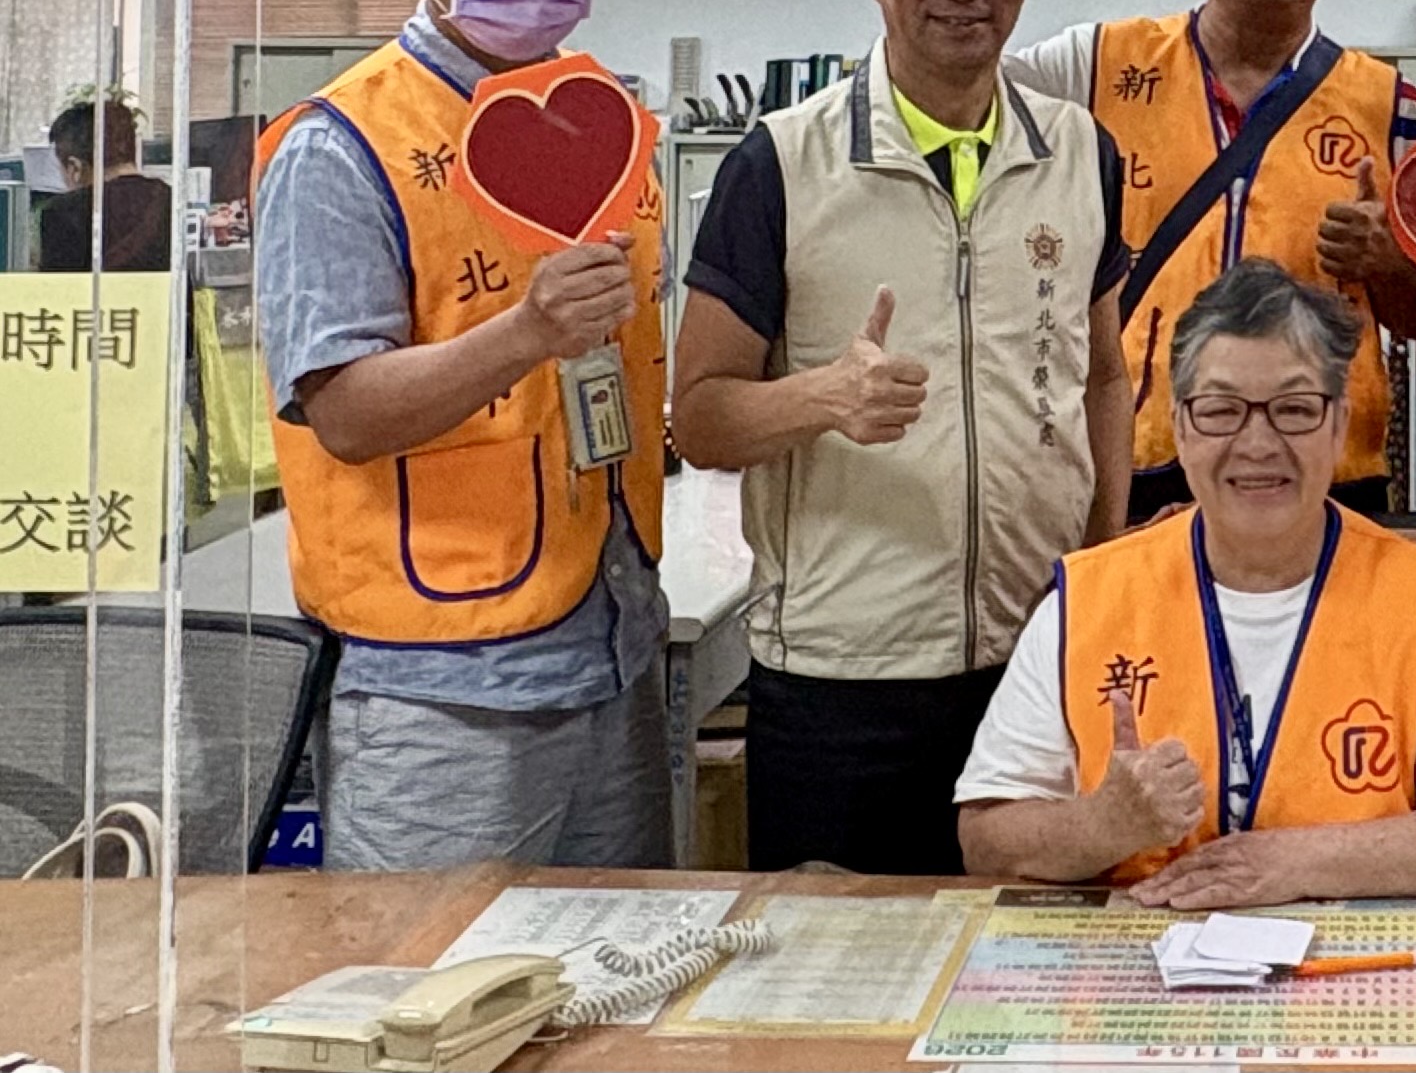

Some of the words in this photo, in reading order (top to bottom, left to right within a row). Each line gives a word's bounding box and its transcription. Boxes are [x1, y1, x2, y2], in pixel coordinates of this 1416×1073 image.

[2, 308, 139, 372] 時間
[0, 491, 135, 553] 交談
[1097, 653, 1159, 716] 新
